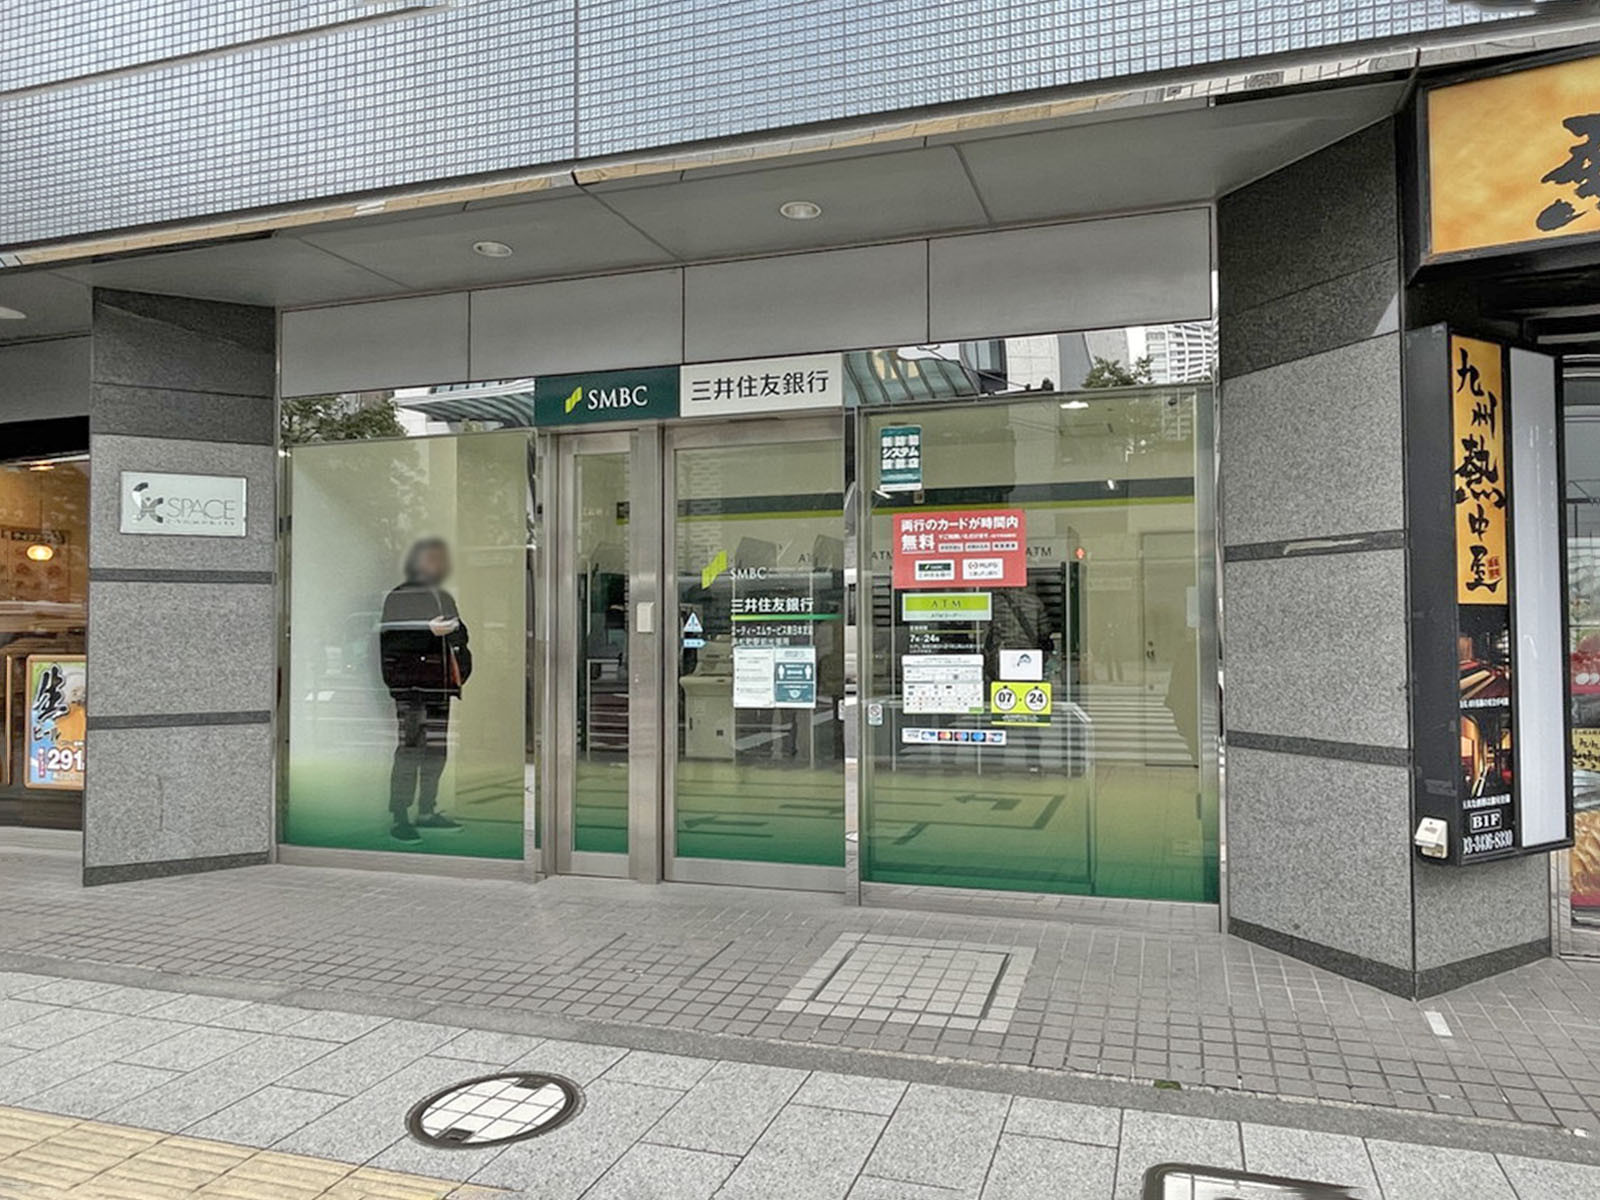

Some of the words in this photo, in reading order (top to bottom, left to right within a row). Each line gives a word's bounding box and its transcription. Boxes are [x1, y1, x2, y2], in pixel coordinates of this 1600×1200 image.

[691, 370, 829, 402] 三井住友銀行
[587, 385, 648, 411] SMBC
[1454, 347, 1507, 593] 九州熱中屋
[166, 497, 236, 520] SPACE
[900, 515, 1019, 532] 両行のカードが時間内
[901, 532, 935, 550] 無料
[729, 566, 768, 580] SMBC
[731, 597, 814, 613] 三井住友銀行
[930, 599, 961, 608] ATM
[32, 665, 69, 721] 生
[998, 692, 1013, 703] 07
[1028, 692, 1044, 704] 24
[47, 747, 85, 771] 291
[1472, 812, 1501, 829] B1F
